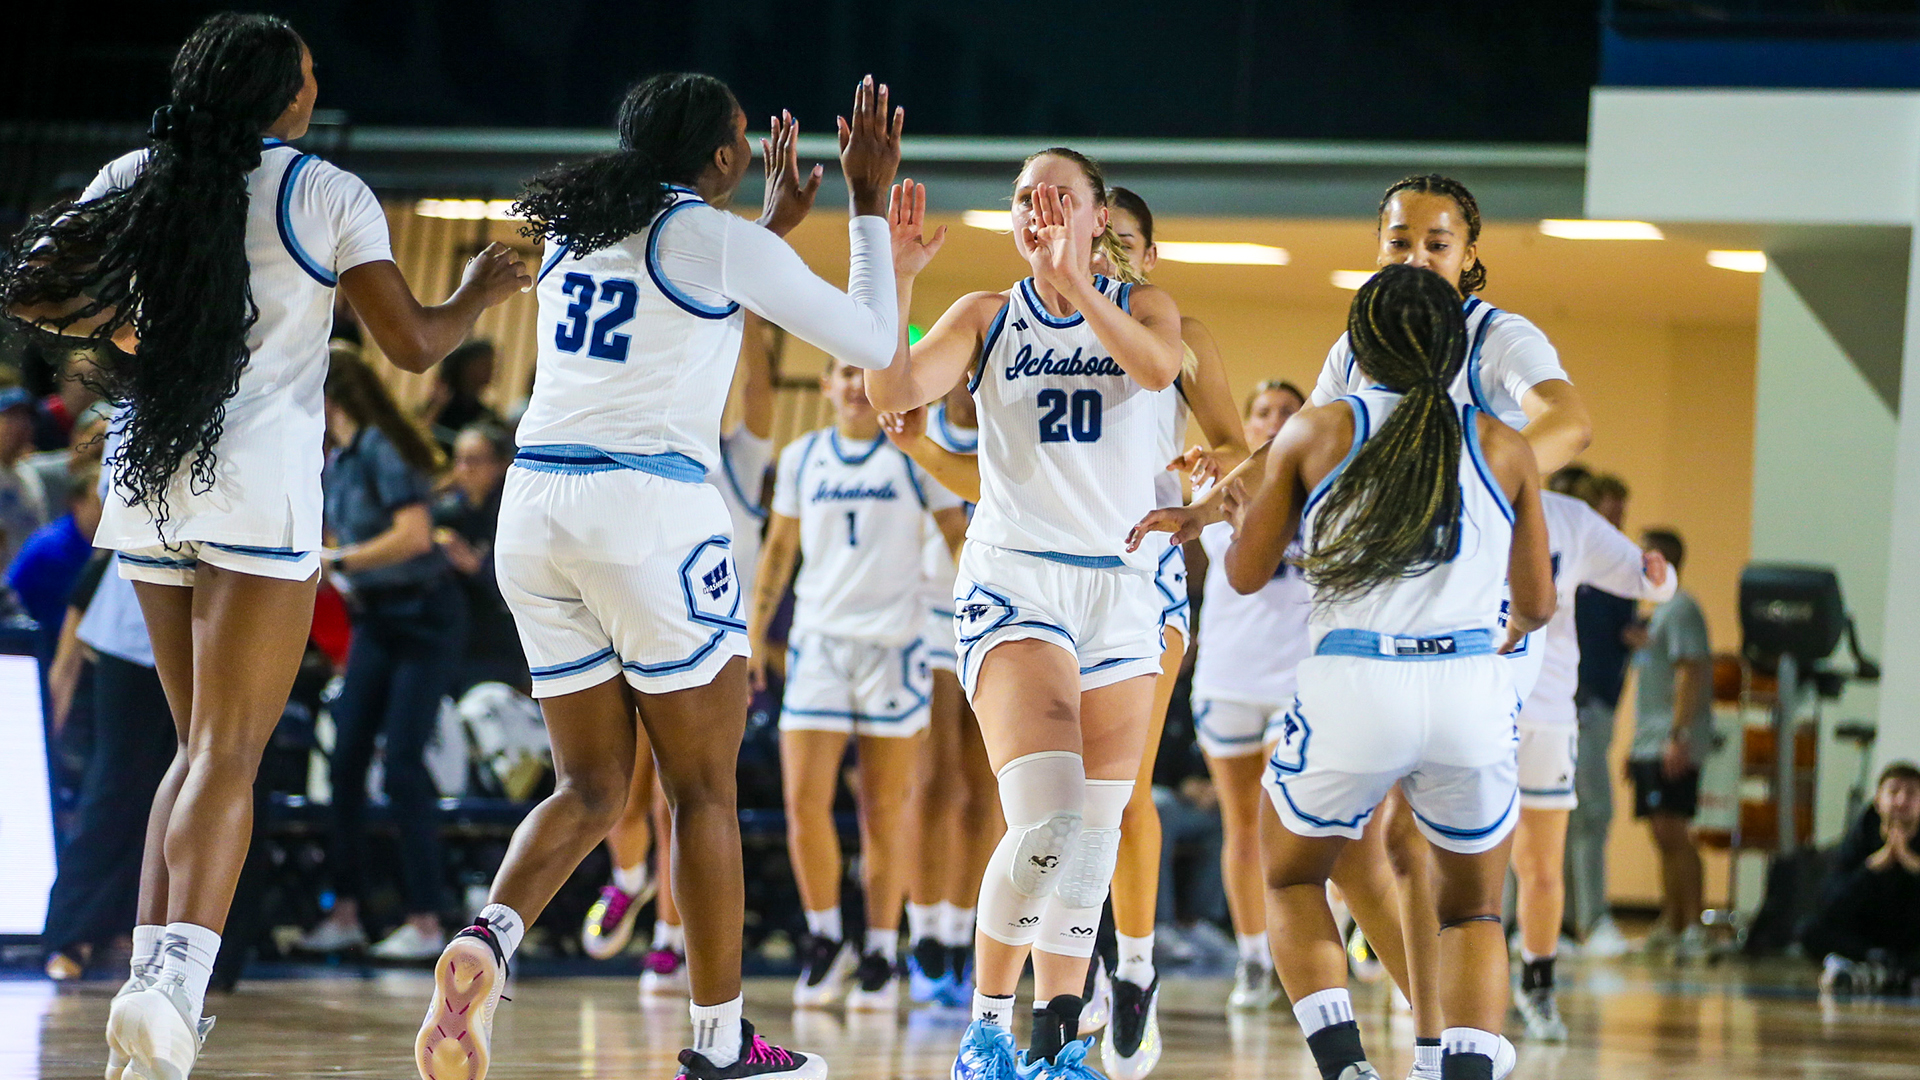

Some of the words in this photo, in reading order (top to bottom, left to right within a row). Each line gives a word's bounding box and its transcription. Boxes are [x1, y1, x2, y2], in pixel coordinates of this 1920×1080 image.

[555, 271, 640, 364] 32
[1037, 388, 1102, 443] 20
[846, 511, 857, 547] 1
